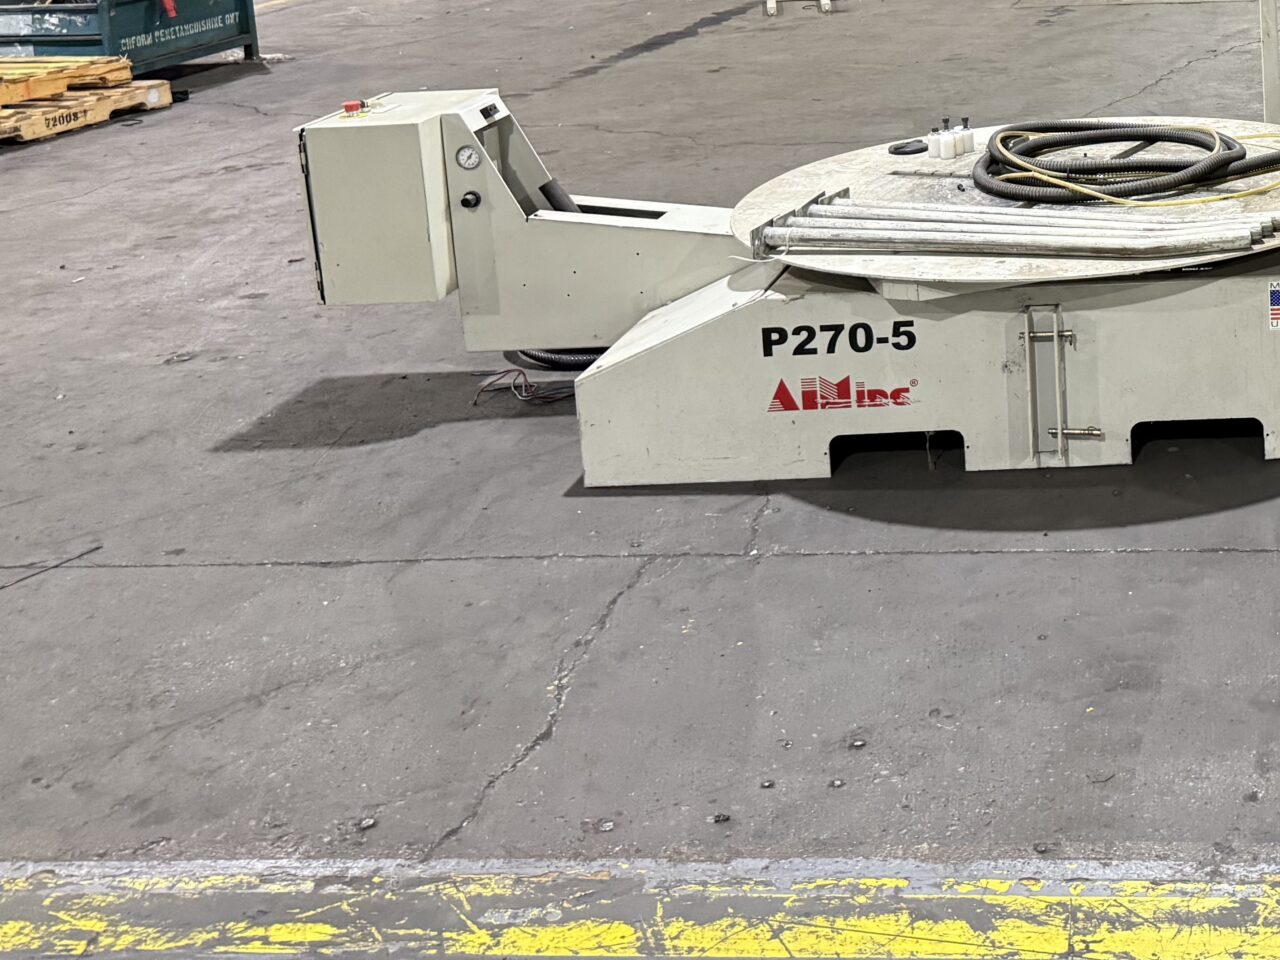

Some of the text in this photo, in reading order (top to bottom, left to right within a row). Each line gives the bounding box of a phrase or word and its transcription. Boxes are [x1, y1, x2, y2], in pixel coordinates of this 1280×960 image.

[45, 111, 79, 128] 72008
[762, 320, 917, 357] P270-5
[767, 375, 911, 412] AIM inc
